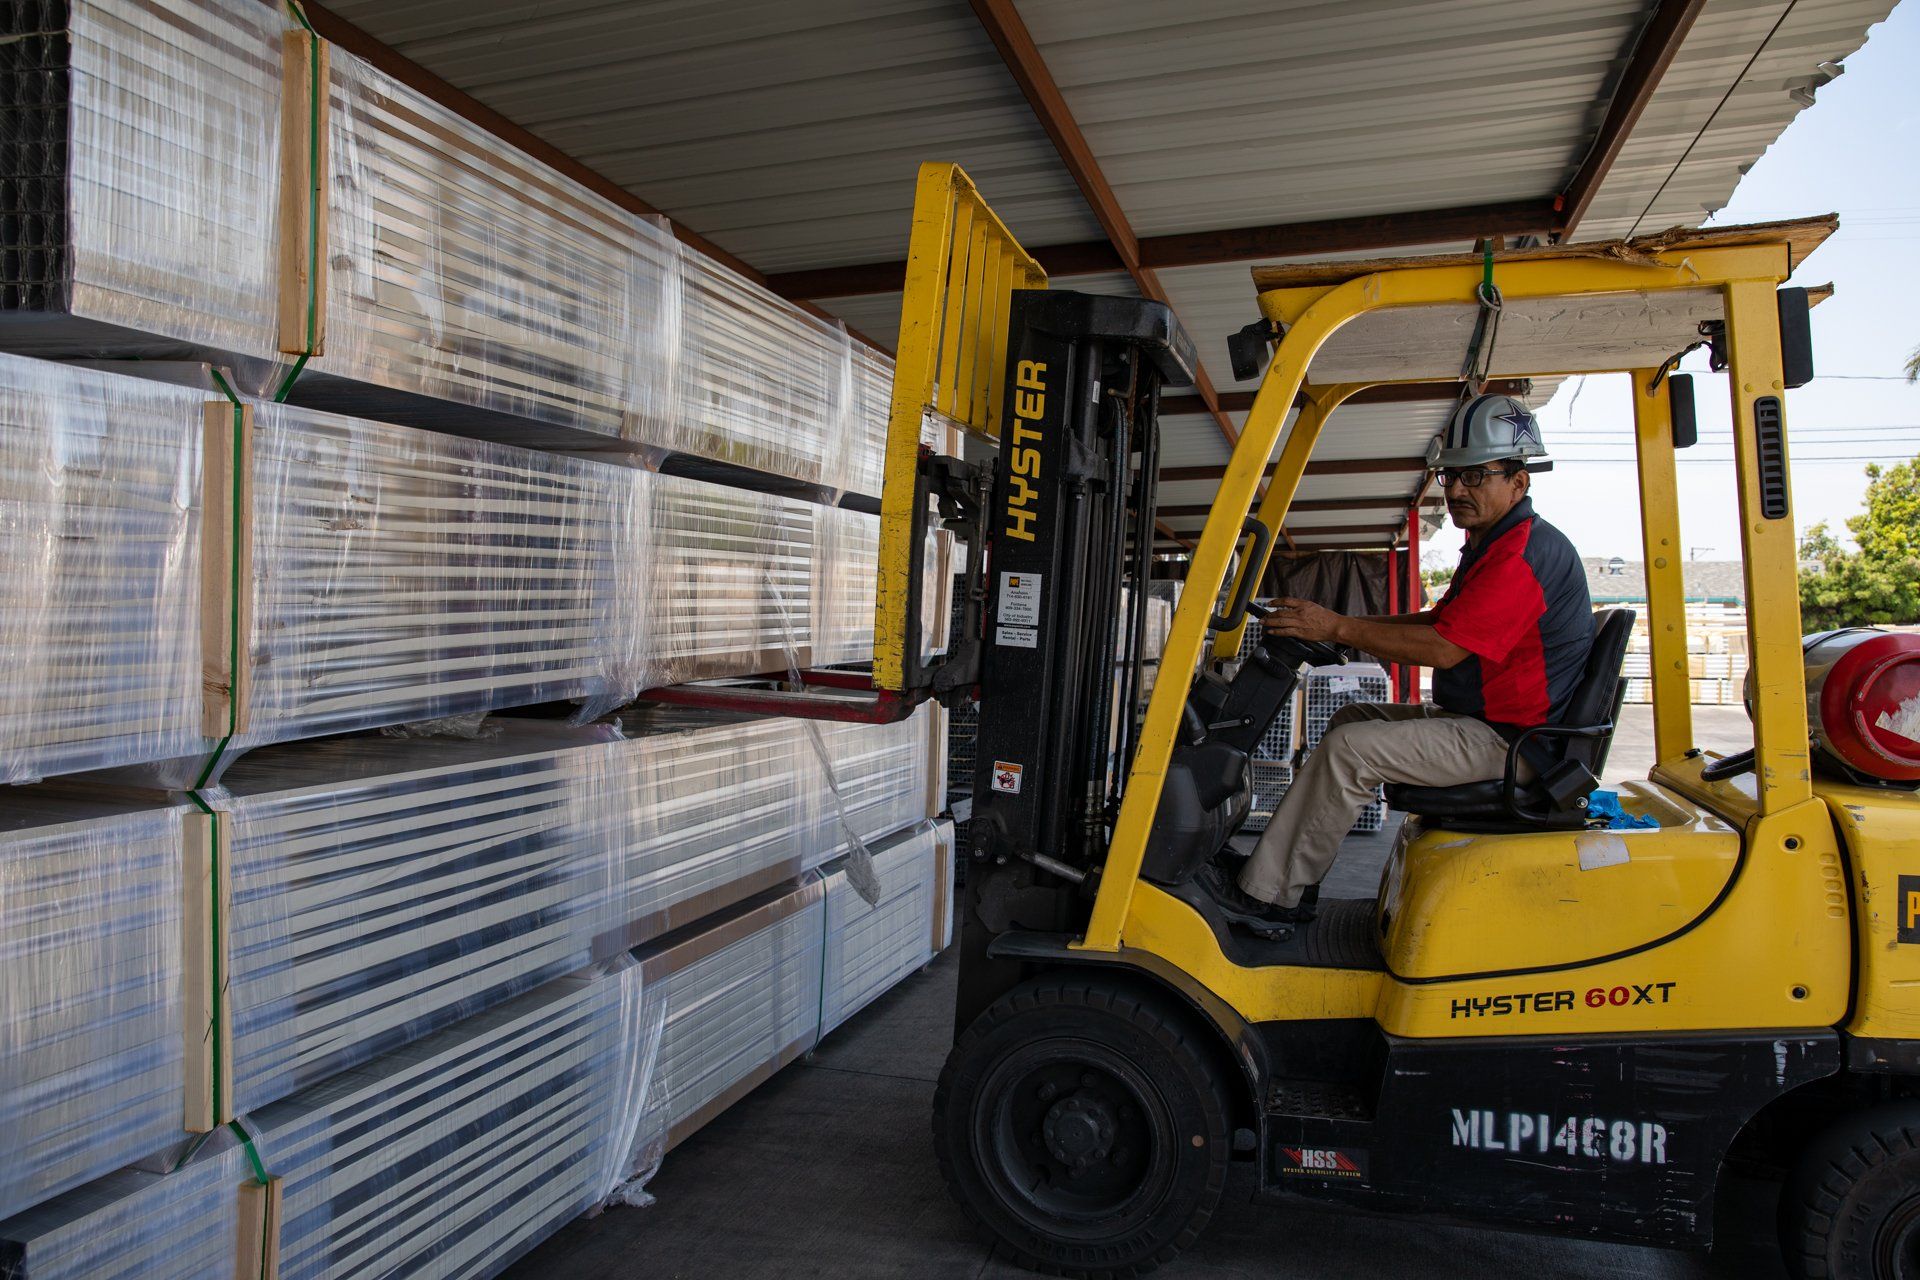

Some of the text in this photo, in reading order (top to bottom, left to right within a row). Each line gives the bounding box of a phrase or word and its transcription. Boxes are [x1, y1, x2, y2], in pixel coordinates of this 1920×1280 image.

[1006, 359, 1047, 542] HYSTER
[1451, 982, 1676, 1018] HYSTER 60XT
[1302, 1149, 1337, 1169] HSS
